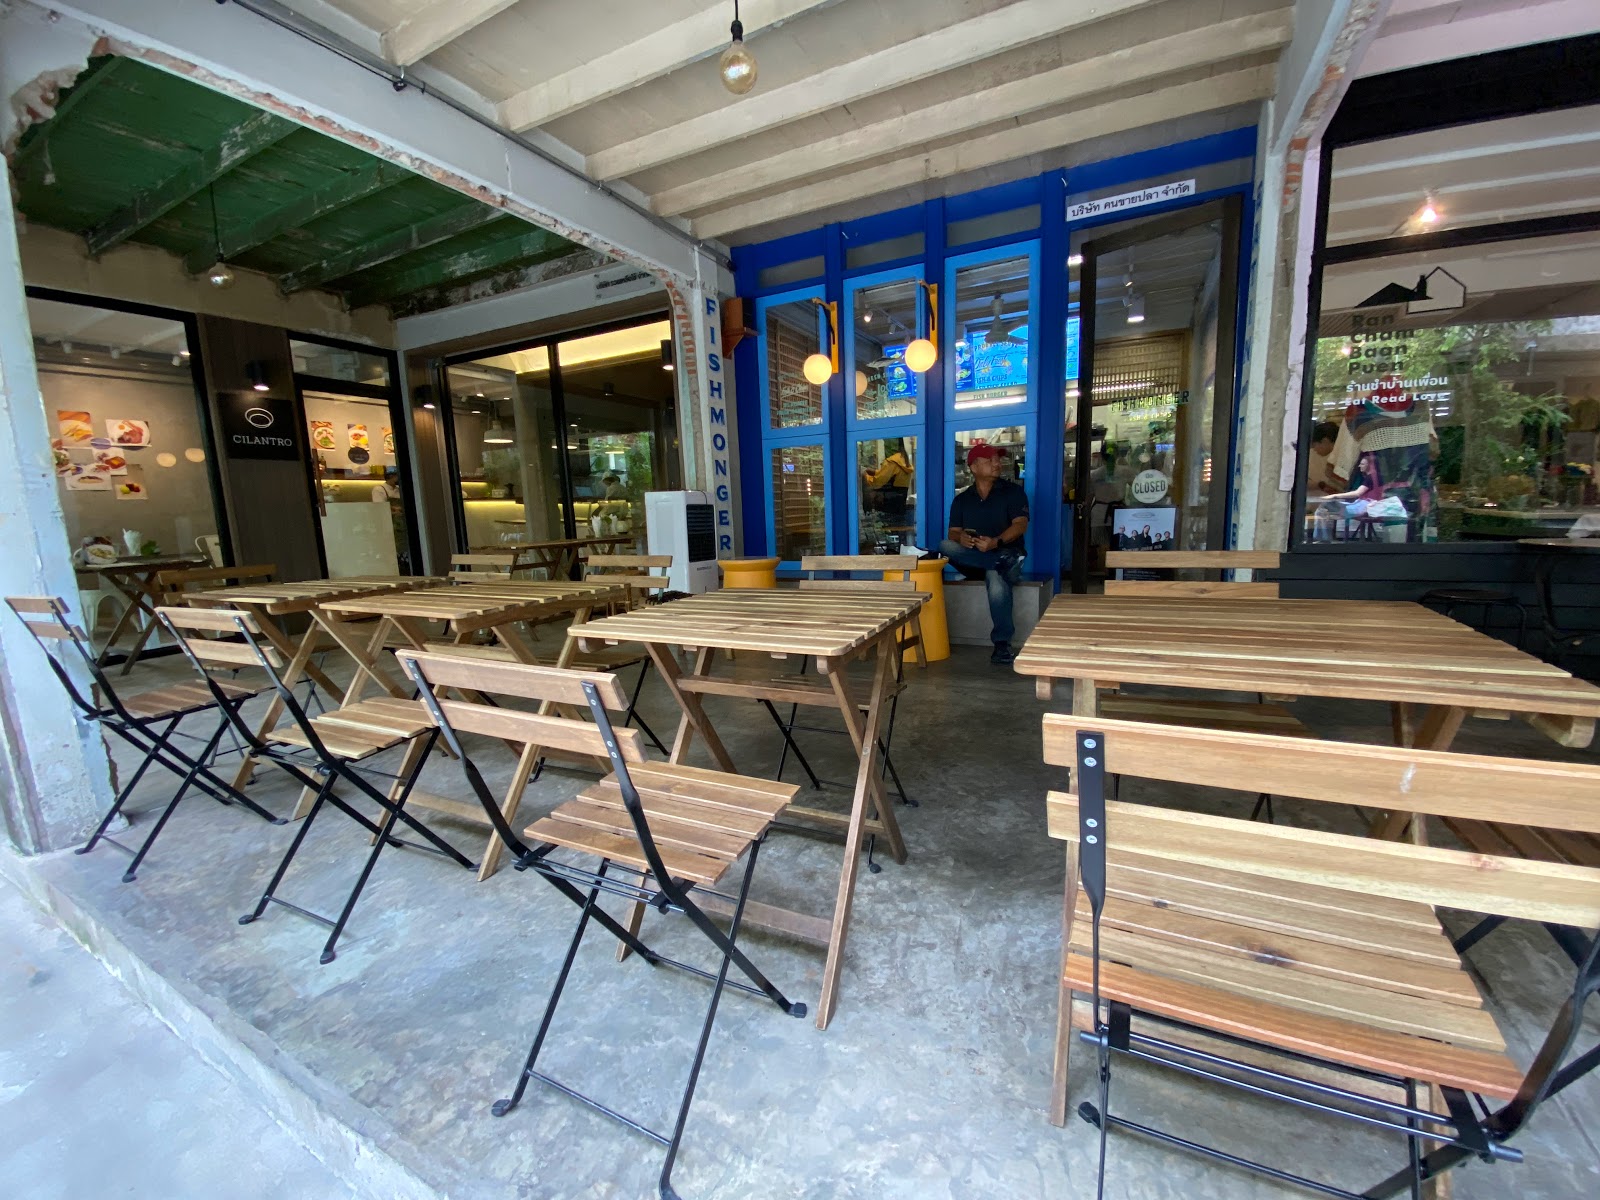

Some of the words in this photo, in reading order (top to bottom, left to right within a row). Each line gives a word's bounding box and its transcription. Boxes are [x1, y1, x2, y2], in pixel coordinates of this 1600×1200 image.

[1071, 202, 1100, 217] บริษัท
[1162, 183, 1190, 197] จำกัด
[1351, 314, 1394, 328] Ran
[1350, 326, 1414, 343] Cham
[1349, 344, 1407, 359] Baan
[1348, 360, 1404, 375] Puen
[1346, 371, 1448, 392] ร้านชำบ้านเพื่อน
[1111, 390, 1190, 413] FISHMONGER
[1344, 396, 1366, 406] Eat
[1371, 392, 1407, 404] Read
[705, 297, 732, 551] FISHMONGER
[232, 434, 293, 447] CILANTRO
[1134, 480, 1166, 494] CLOSED
